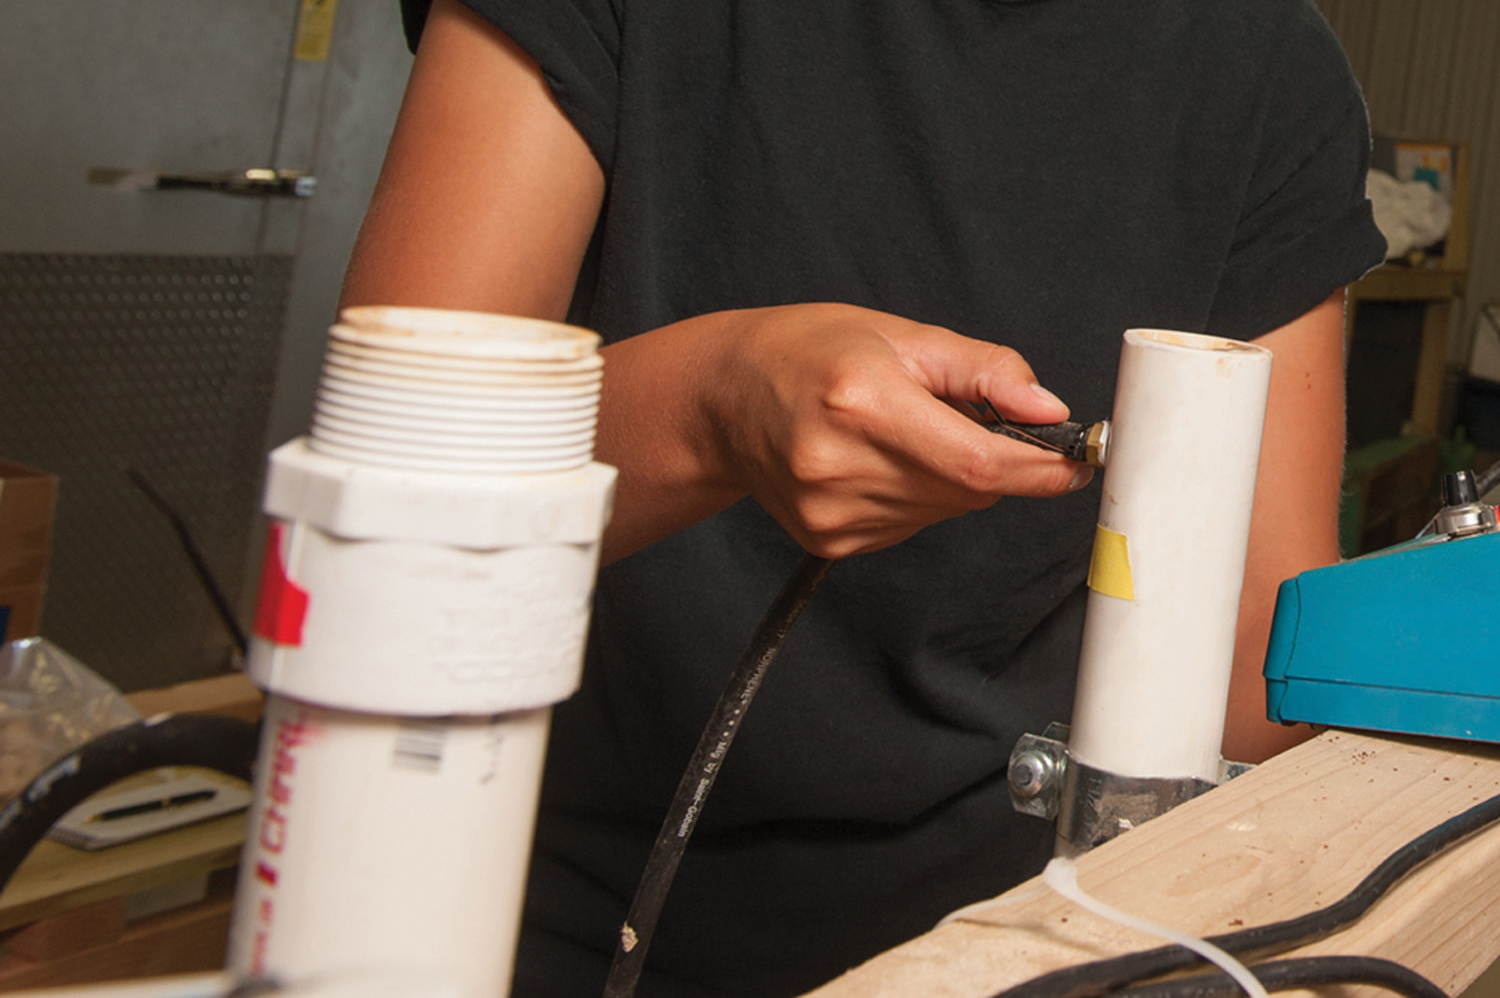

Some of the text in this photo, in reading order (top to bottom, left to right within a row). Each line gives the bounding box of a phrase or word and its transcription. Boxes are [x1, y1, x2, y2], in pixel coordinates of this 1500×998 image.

[710, 741, 728, 759] Mfg
[703, 762, 717, 774] by
[677, 778, 710, 838] Saint-Gobain
